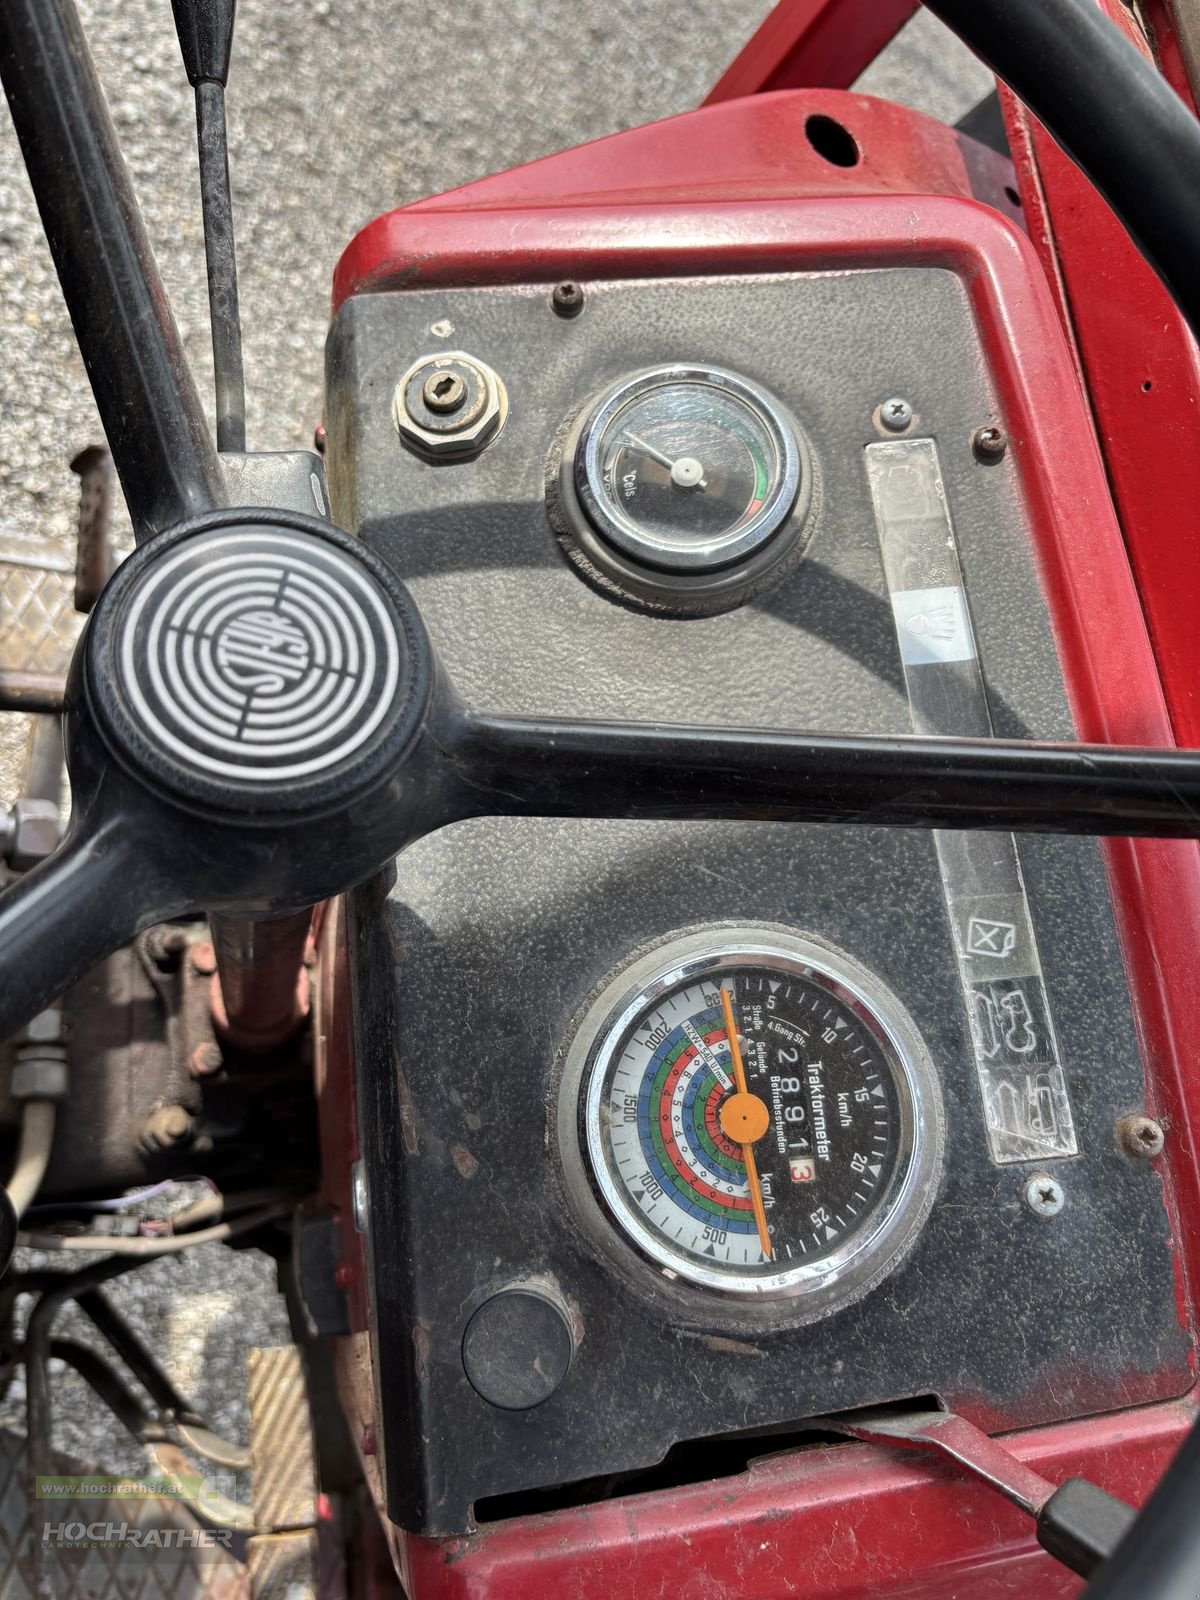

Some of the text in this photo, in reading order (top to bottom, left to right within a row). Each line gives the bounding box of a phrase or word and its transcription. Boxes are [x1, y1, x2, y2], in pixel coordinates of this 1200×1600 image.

[766, 995, 776, 1009] 5
[644, 1021, 672, 1051] 2000
[793, 1033, 806, 1048] Str.
[821, 1026, 838, 1044] 10
[701, 1047, 713, 1062] 540
[854, 1086, 870, 1102] 15
[623, 1094, 638, 1123] 1500
[770, 1075, 788, 1154] Betriebsstunden
[807, 1060, 832, 1162] Traktormeter
[837, 1092, 852, 1127] km/h
[688, 1158, 698, 1167] 3
[712, 1178, 720, 1188] 2
[850, 1152, 868, 1173] 20
[638, 1170, 664, 1201] 1000
[760, 1173, 776, 1208] km/h
[810, 1206, 830, 1228] 25
[701, 1225, 727, 1245] 500
